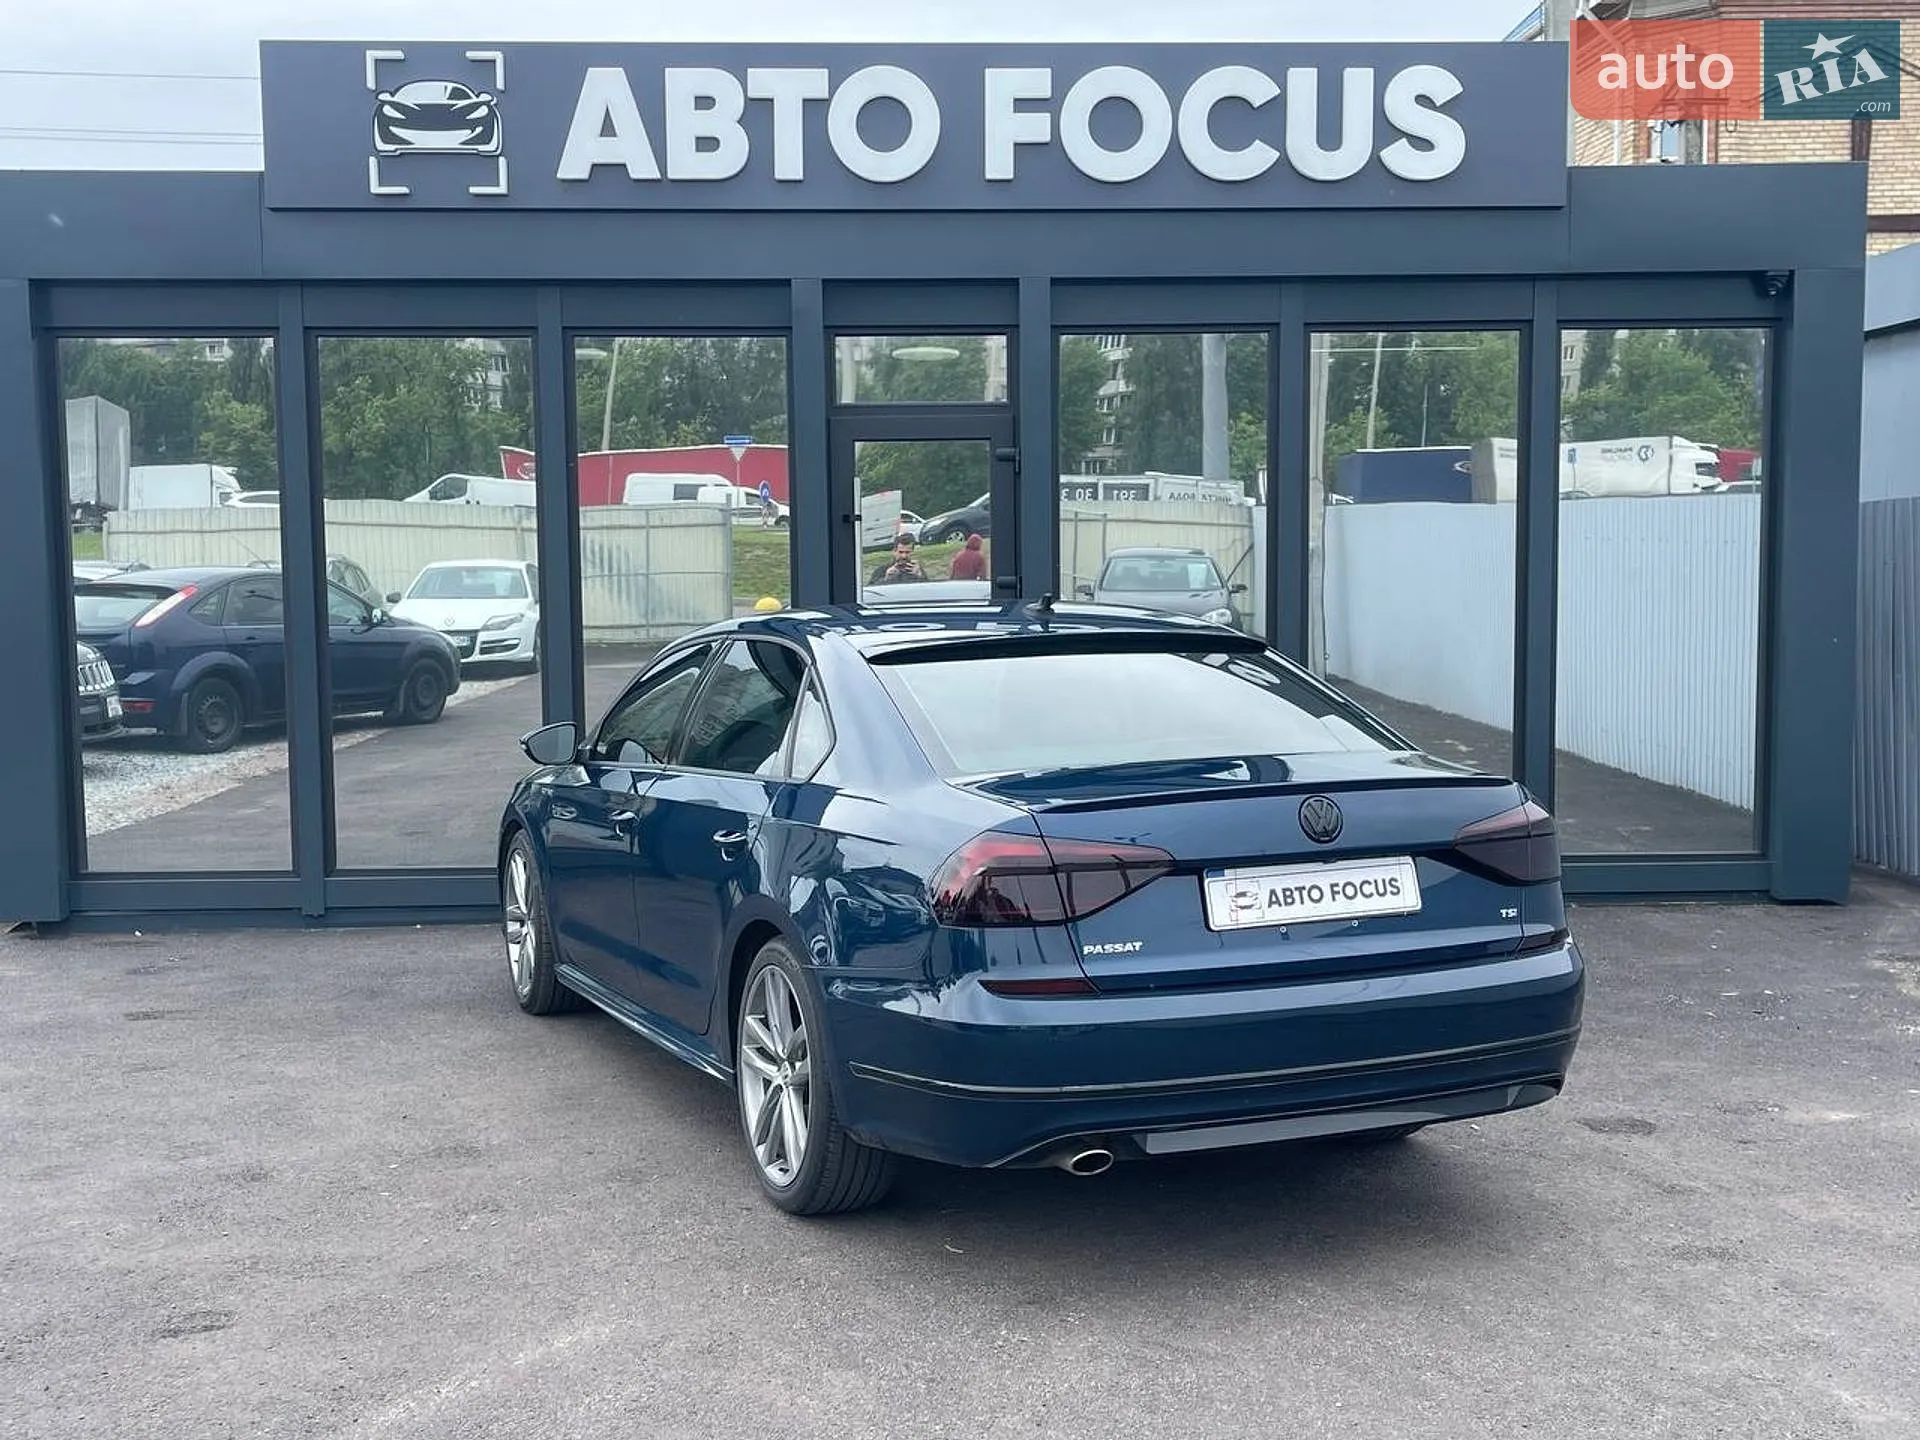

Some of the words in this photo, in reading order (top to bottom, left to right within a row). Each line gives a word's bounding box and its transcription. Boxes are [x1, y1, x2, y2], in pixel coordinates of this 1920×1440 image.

[556, 64, 941, 183] АВТО
[982, 64, 1467, 183] FOCUS
[1267, 884, 1324, 908] АВТО
[1329, 877, 1401, 902] FOCUS
[1083, 941, 1143, 955] PASSAT
